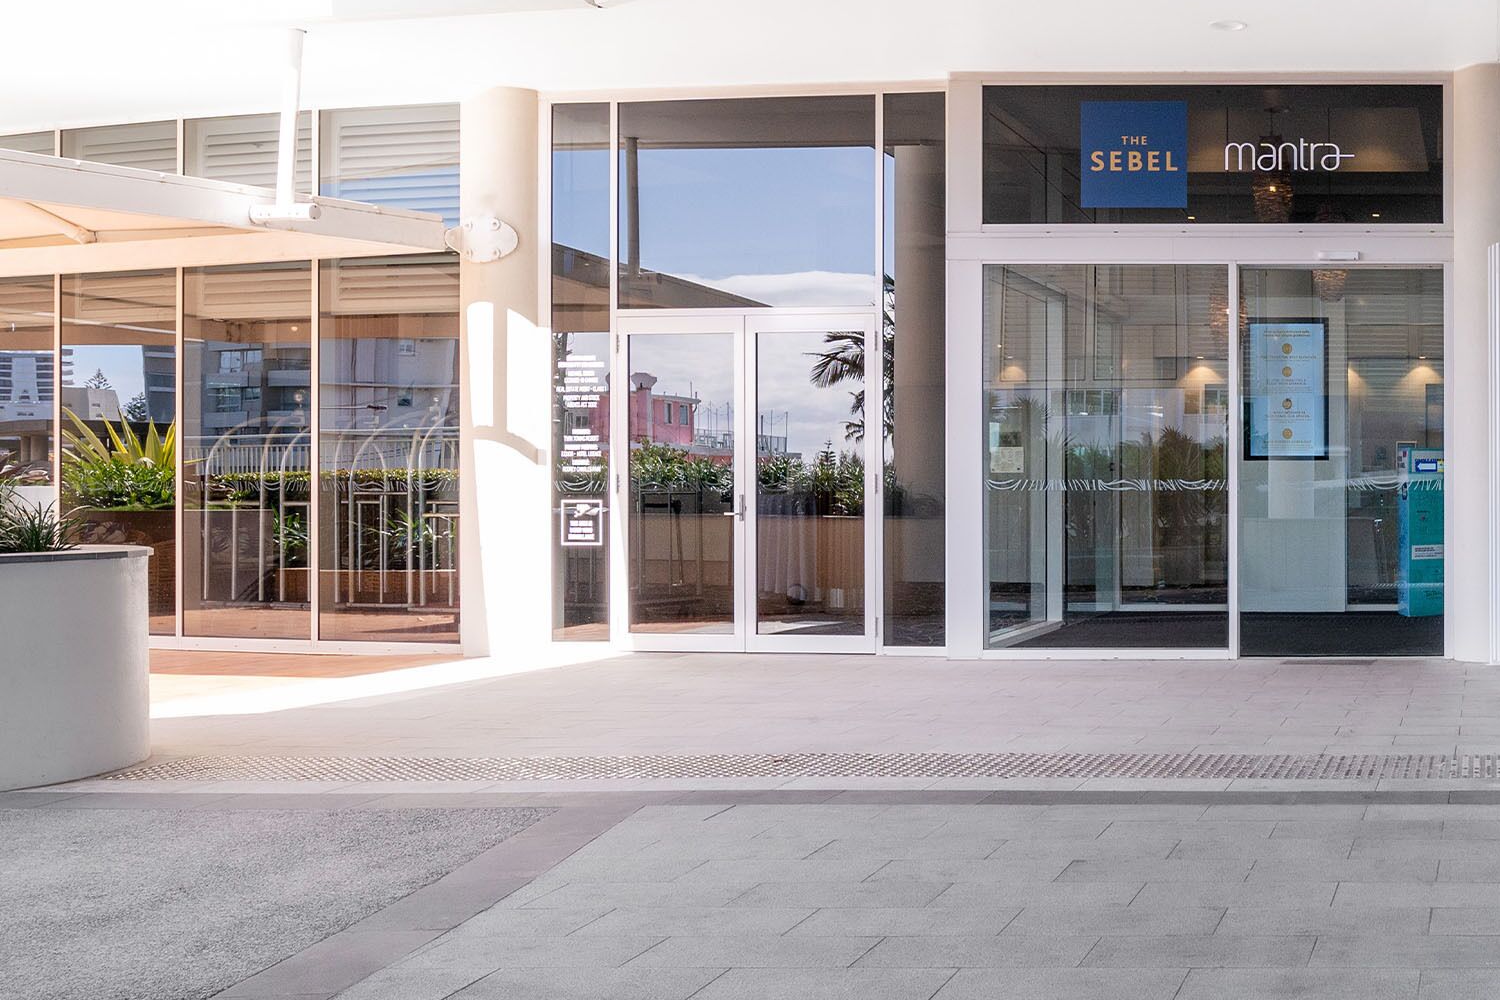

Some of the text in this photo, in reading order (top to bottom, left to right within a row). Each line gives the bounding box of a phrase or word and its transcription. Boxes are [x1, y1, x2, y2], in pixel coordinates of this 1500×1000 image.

[1121, 135, 1147, 145] THE
[1090, 150, 1178, 172] SEBEL
[1224, 137, 1355, 171] mantra
